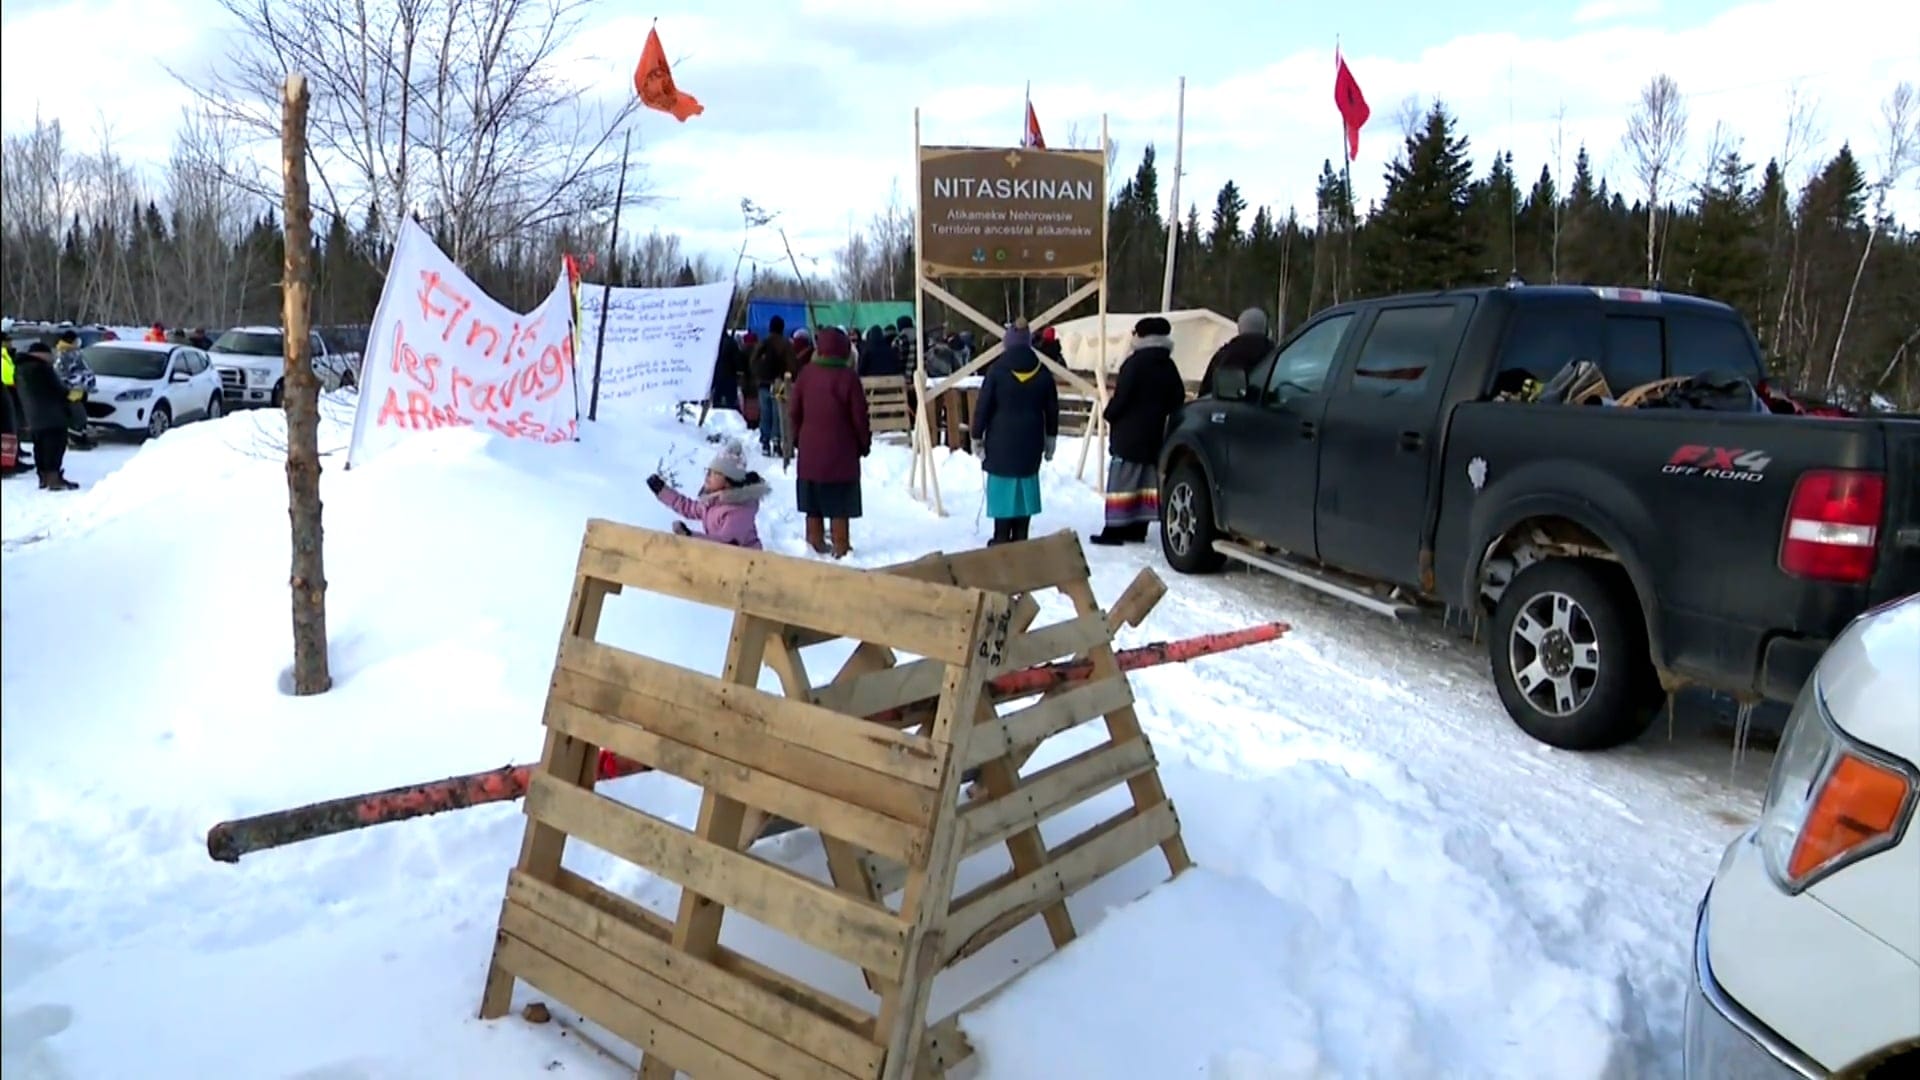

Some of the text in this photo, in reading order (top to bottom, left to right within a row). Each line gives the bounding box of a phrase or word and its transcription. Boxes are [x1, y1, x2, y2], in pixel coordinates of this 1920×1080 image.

[933, 177, 1093, 200] NITASKINAN
[947, 208, 1073, 222] Atikamekw Nehirowisiw
[931, 223, 1092, 237] Territoire ancestral atikamekw
[392, 319, 442, 392] les
[1669, 444, 1772, 471] FX4
[1661, 465, 1764, 481] OFF ROAD
